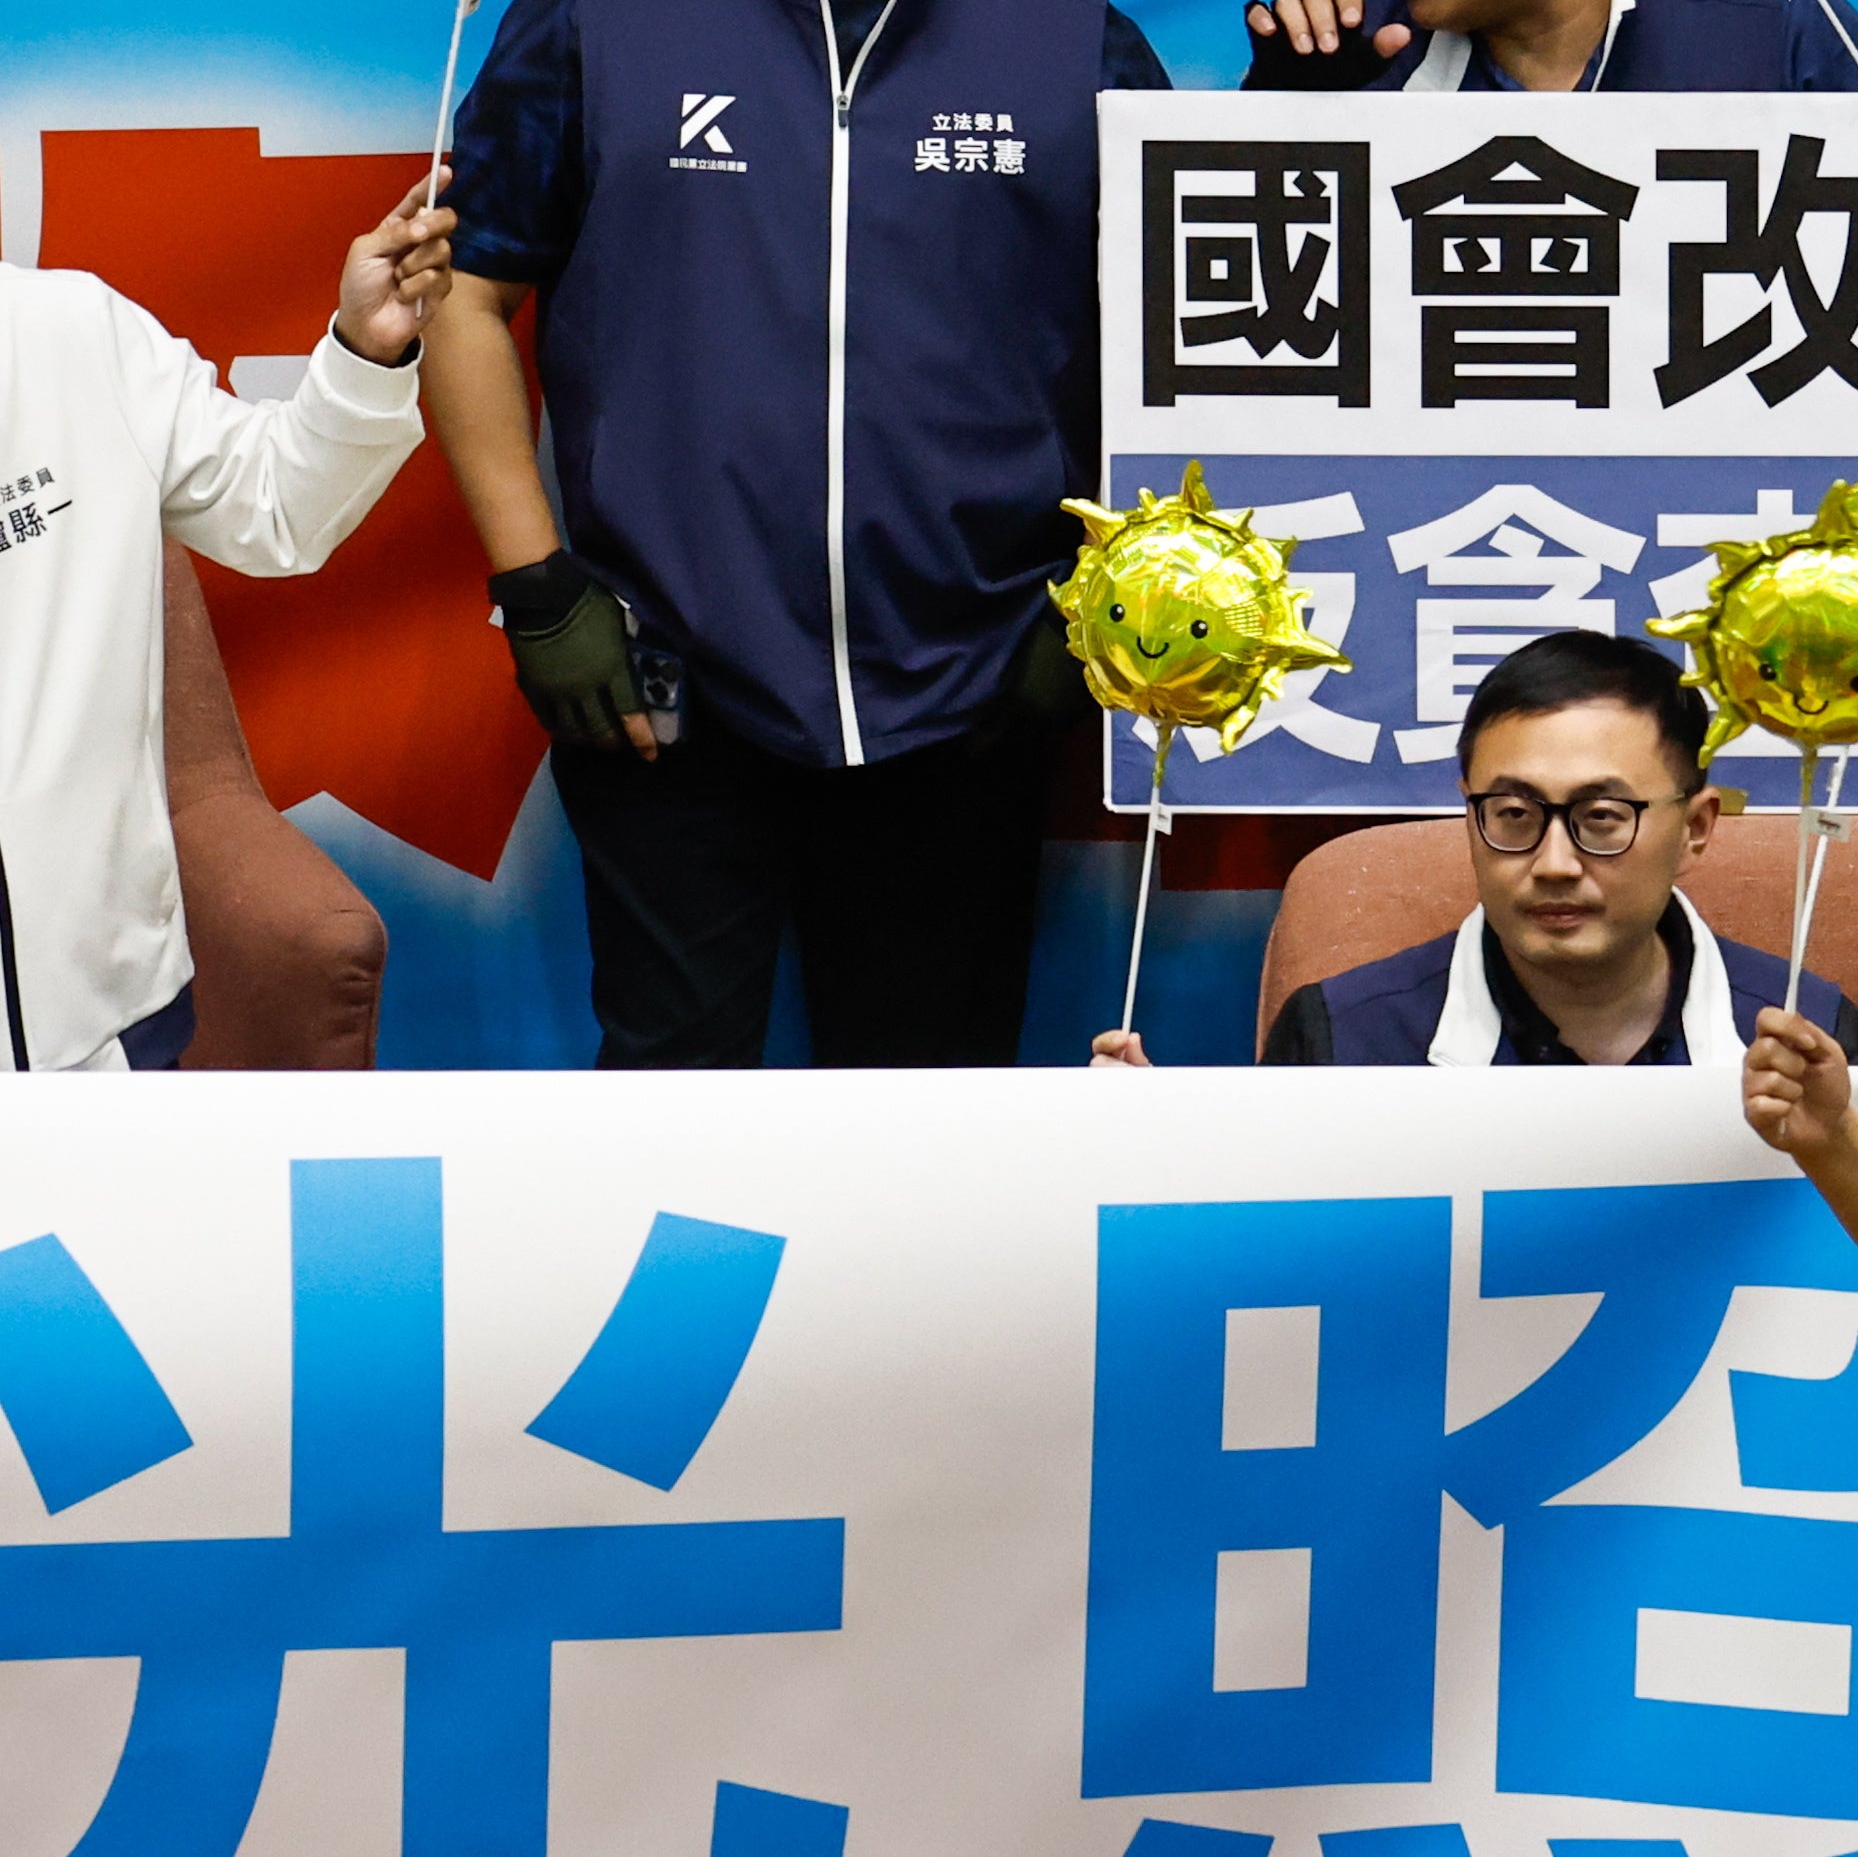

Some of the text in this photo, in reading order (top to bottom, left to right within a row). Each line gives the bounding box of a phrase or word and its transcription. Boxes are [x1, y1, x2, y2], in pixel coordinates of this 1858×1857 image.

[932, 113, 1014, 133] 立法委員
[914, 137, 1026, 175] 吳宗憲
